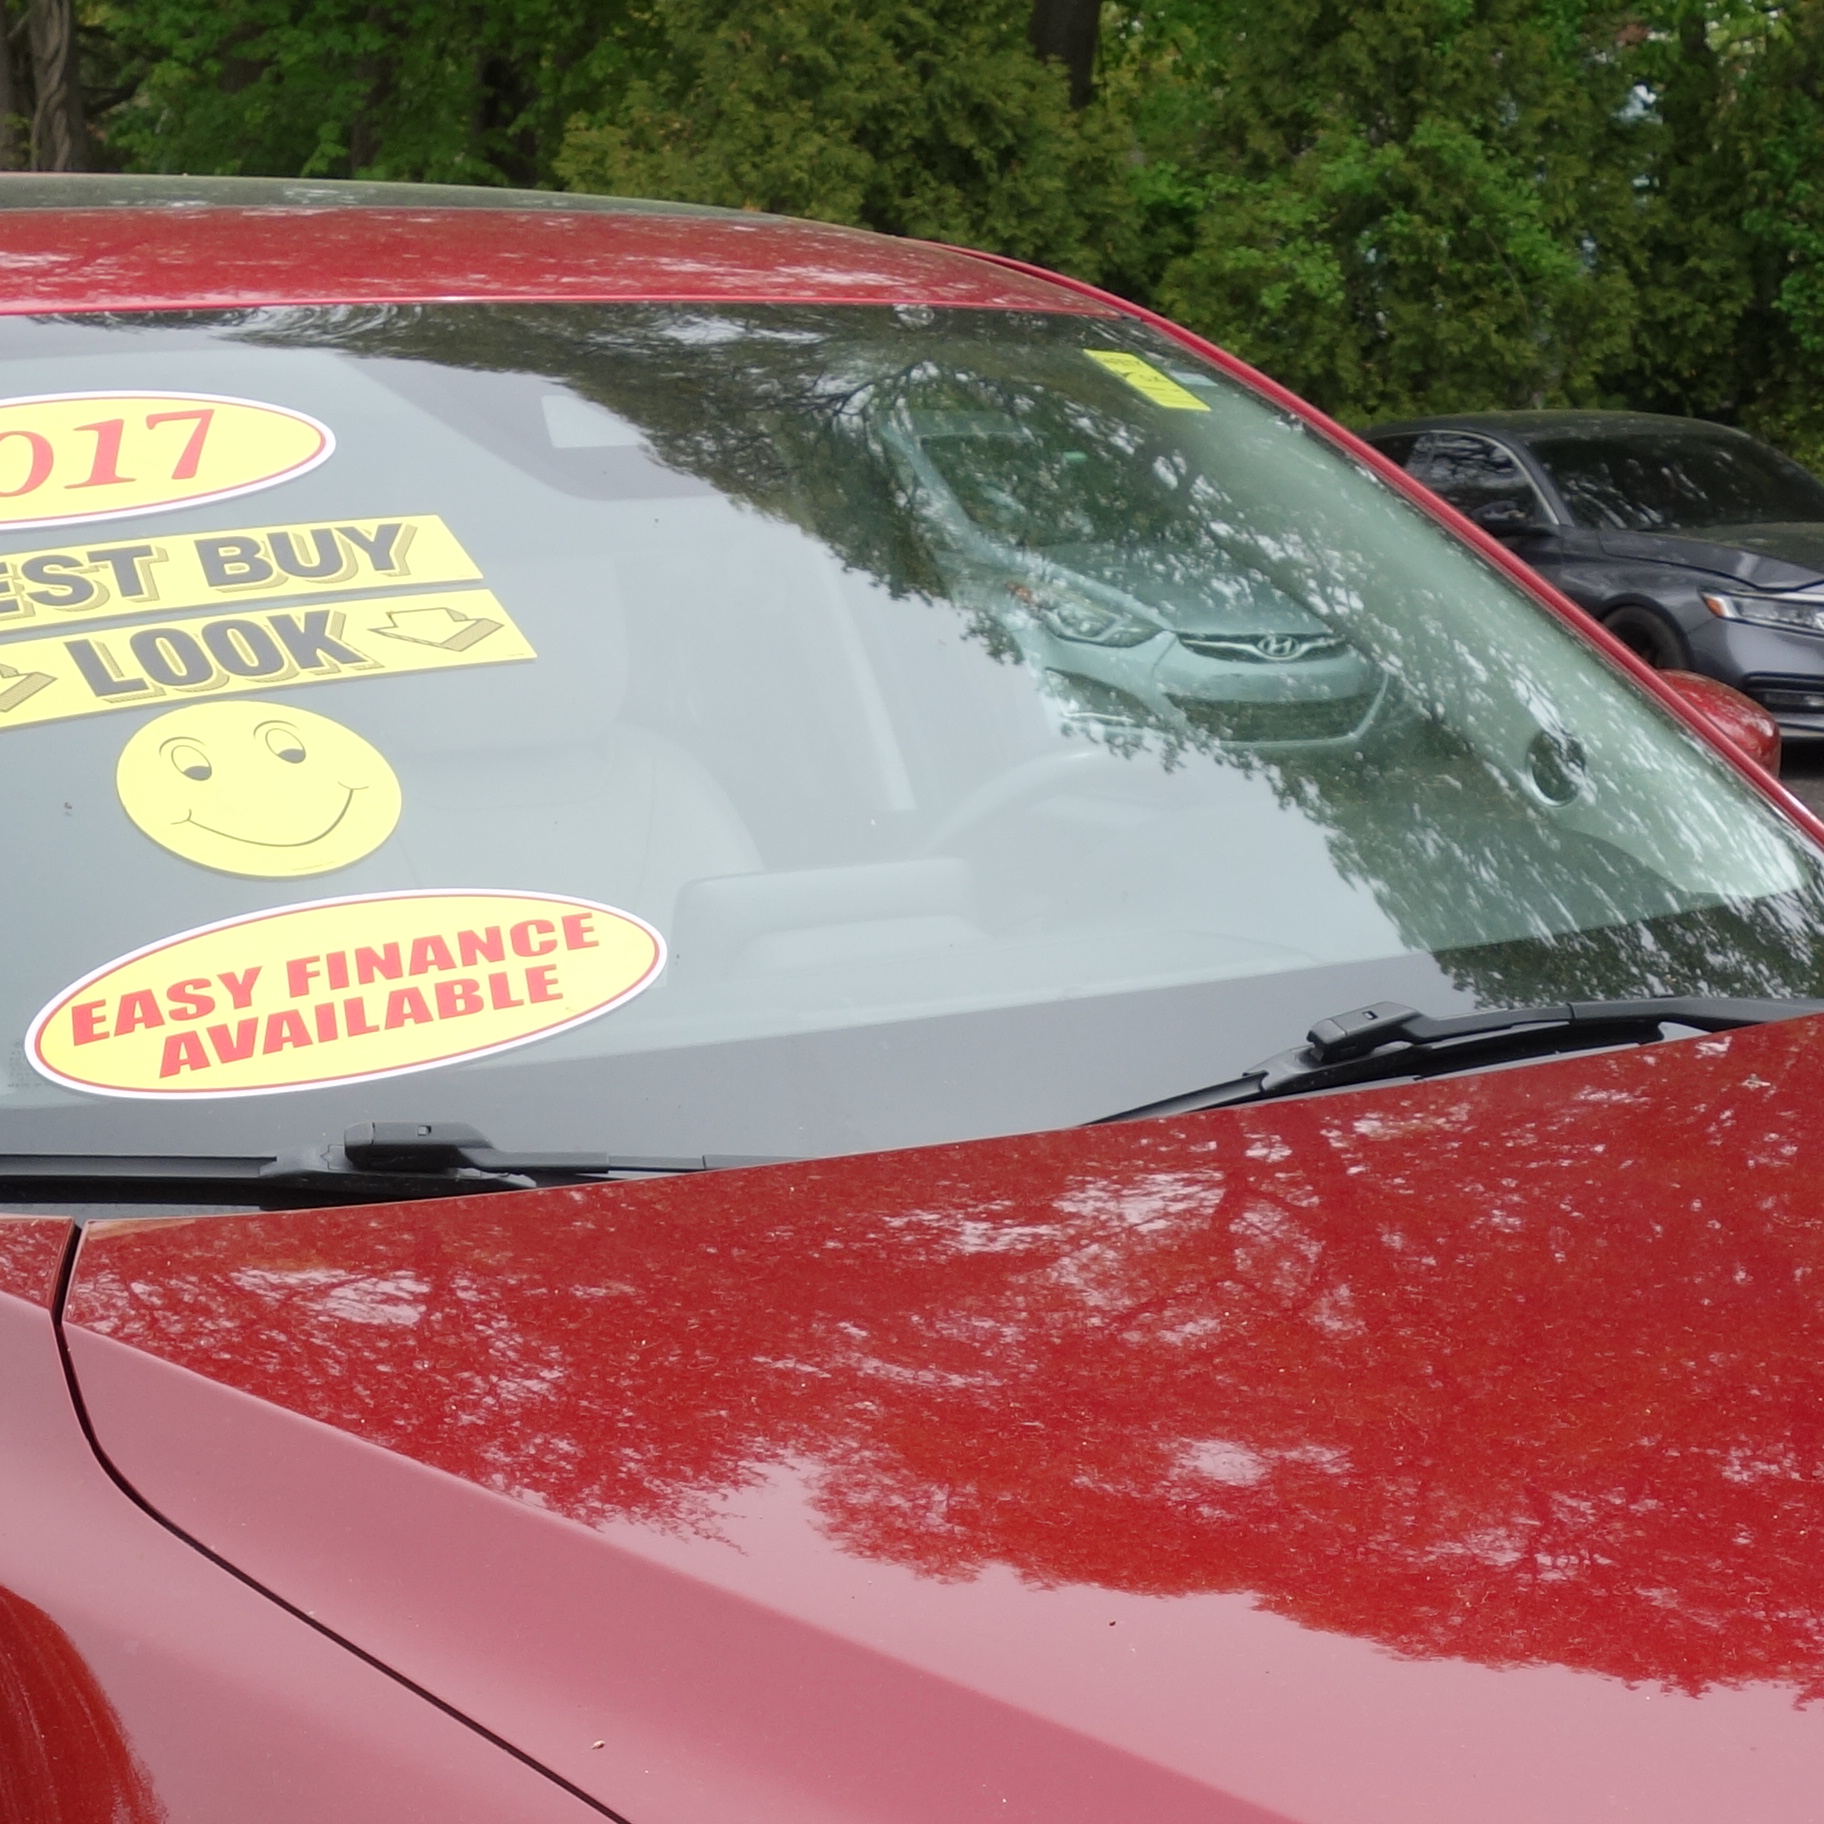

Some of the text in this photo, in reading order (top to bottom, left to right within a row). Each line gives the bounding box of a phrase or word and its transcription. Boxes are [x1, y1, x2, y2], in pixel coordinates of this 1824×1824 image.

[193, 522, 412, 590] BUY
[64, 609, 378, 701] LOOK
[71, 911, 600, 1047] EASY FINANCE
[158, 963, 564, 1080] AVAILABLE
